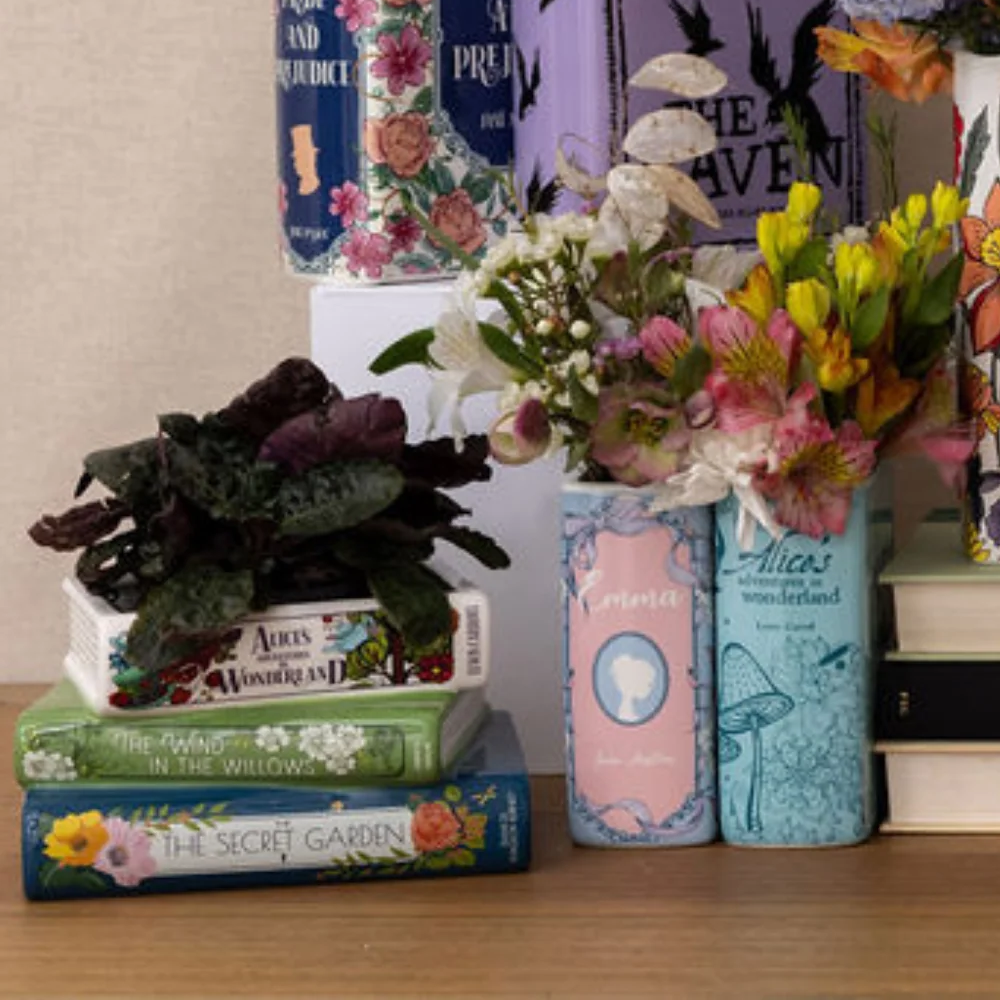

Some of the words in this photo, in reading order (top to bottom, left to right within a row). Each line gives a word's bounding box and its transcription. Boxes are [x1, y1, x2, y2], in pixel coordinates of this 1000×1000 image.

[289, 22, 320, 49] AND
[741, 586, 841, 605] wonderland
[214, 659, 347, 694] WONDERLAND
[161, 730, 225, 755] WIND
[149, 756, 169, 775] IN
[178, 756, 213, 775] THE
[223, 756, 315, 776] WILLOWS
[164, 834, 204, 858] THE
[216, 827, 293, 855] SECRET
[304, 820, 405, 852] GARDEN
